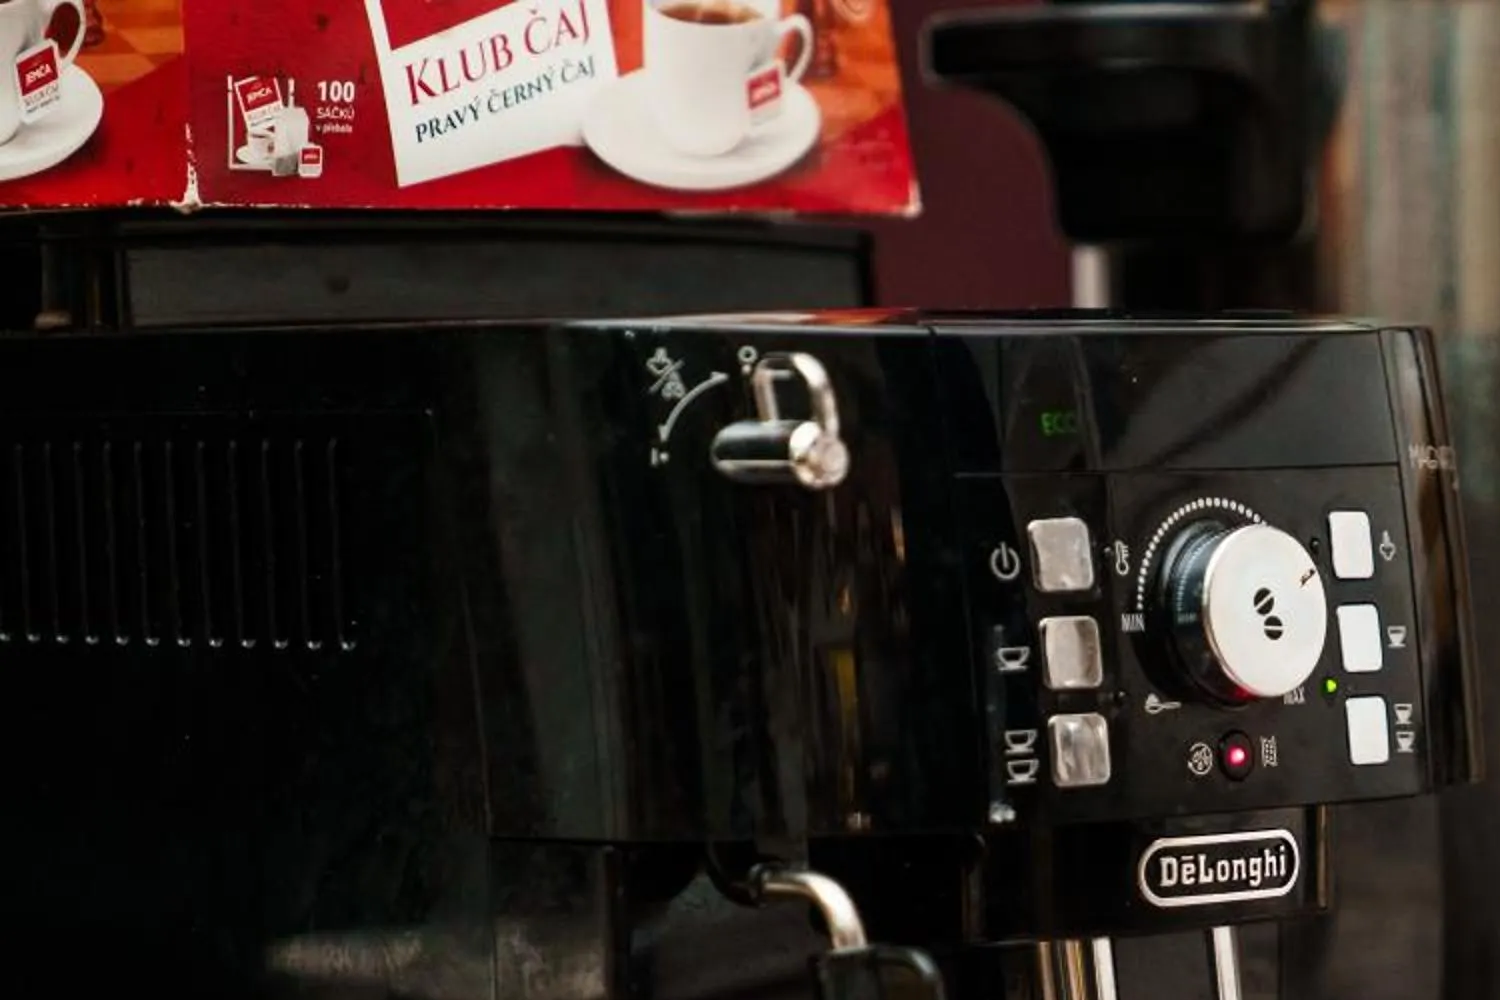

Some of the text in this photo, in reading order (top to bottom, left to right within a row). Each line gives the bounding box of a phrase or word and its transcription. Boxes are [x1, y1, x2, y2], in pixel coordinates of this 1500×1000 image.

[317, 80, 355, 102] 100
[405, 0, 590, 105] KLUB ČAJ
[414, 55, 596, 143] PRAVÝ ČERNÝ ČAJ
